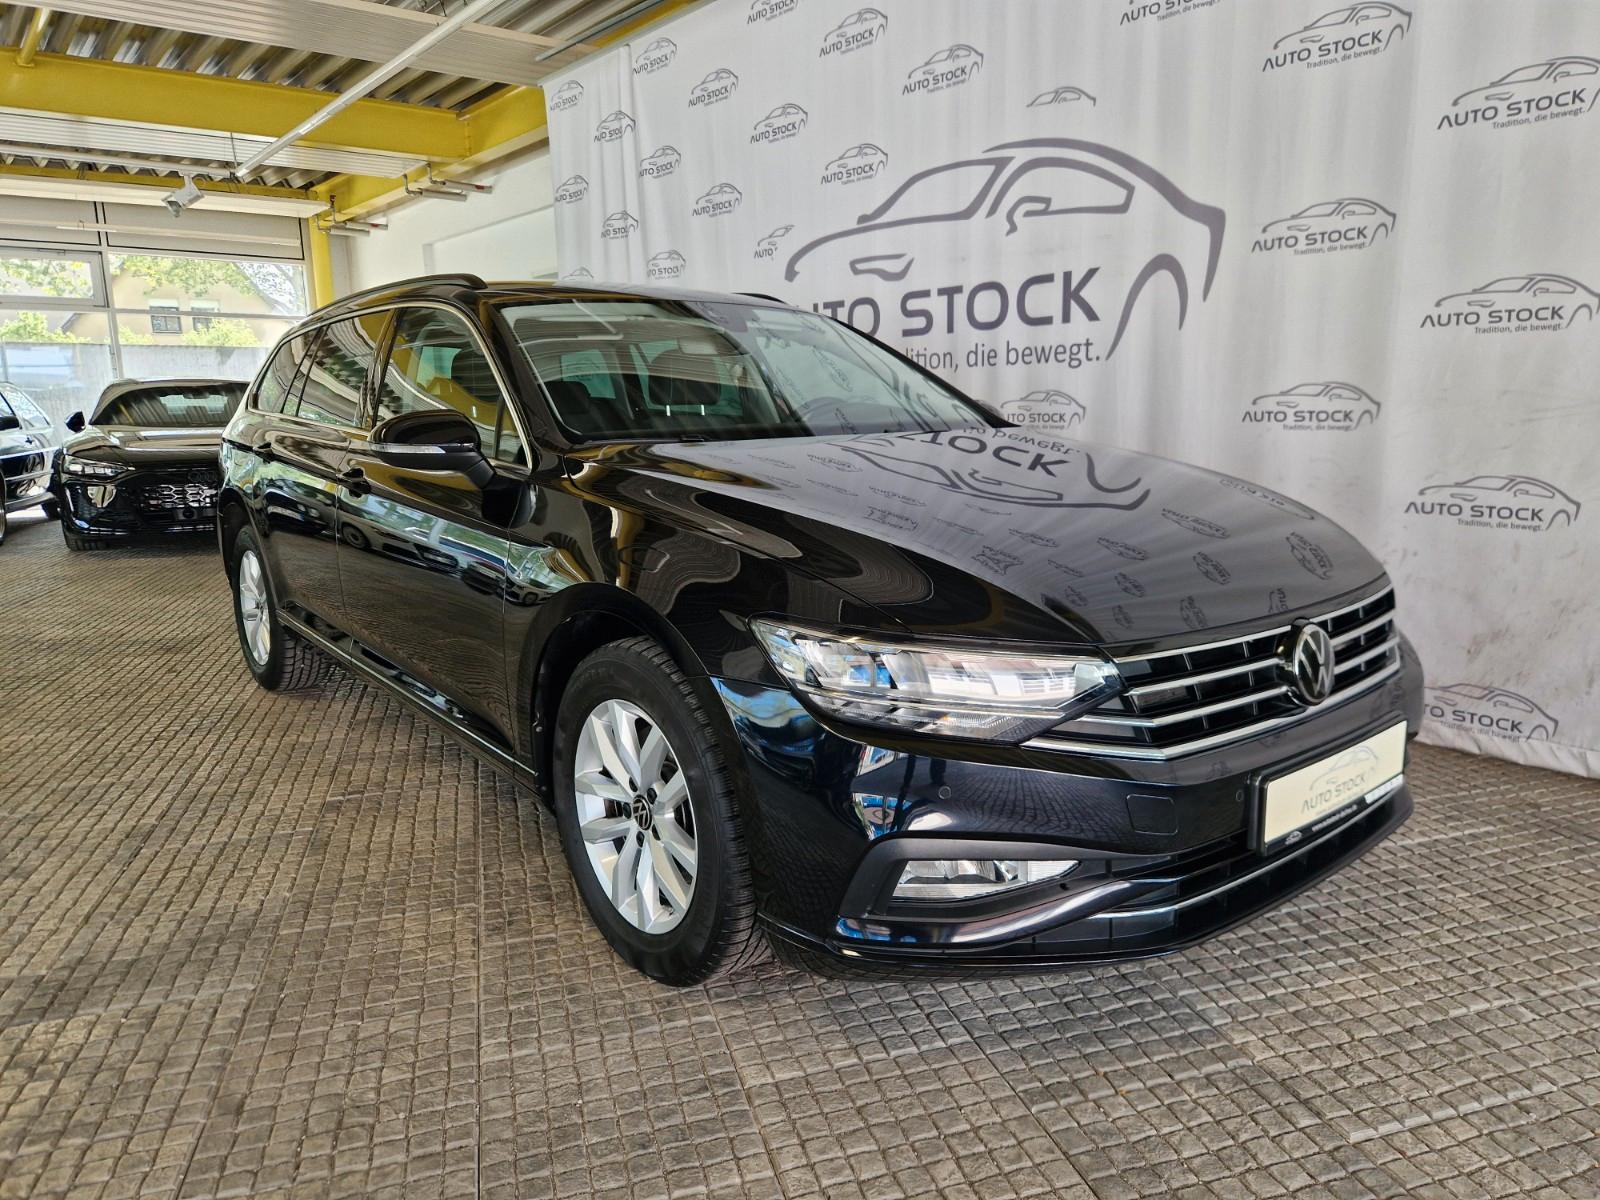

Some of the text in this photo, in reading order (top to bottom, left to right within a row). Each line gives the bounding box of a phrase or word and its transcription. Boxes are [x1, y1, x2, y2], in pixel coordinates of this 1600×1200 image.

[747, 8, 767, 24] AUTO
[1119, 2, 1161, 26] AUTO
[819, 41, 843, 58] AUTO
[845, 27, 874, 47] STOCK
[1262, 29, 1383, 72] AUTO STOCK
[902, 78, 930, 96] AUTO
[932, 65, 967, 86] STOCK
[688, 94, 706, 108] AUTO
[706, 85, 729, 100] STOCK
[1437, 87, 1586, 130] AUTO STOCK
[1492, 106, 1586, 130] Tradition, die bewegt.
[750, 130, 770, 144] AUTO
[772, 121, 797, 137] STOCK
[821, 171, 844, 185] AUTO
[845, 163, 874, 179] STOCK
[692, 206, 711, 216] AUTO
[712, 200, 732, 212] STOCK
[1251, 225, 1368, 253] AUTO STOCK
[754, 248, 774, 259] AUTO
[900, 267, 1101, 338] STOCK
[1420, 305, 1564, 328] AUTO STOCK
[1514, 324, 1528, 332] die
[966, 343, 998, 368] die
[1006, 338, 1100, 370] bewegt.
[1028, 412, 1066, 423] STOCK
[1242, 410, 1353, 423] AUTO STOCK
[1404, 501, 1544, 522] AUTO STOCK
[1452, 710, 1523, 733] STOCK
[1301, 789, 1333, 814] AUTO
